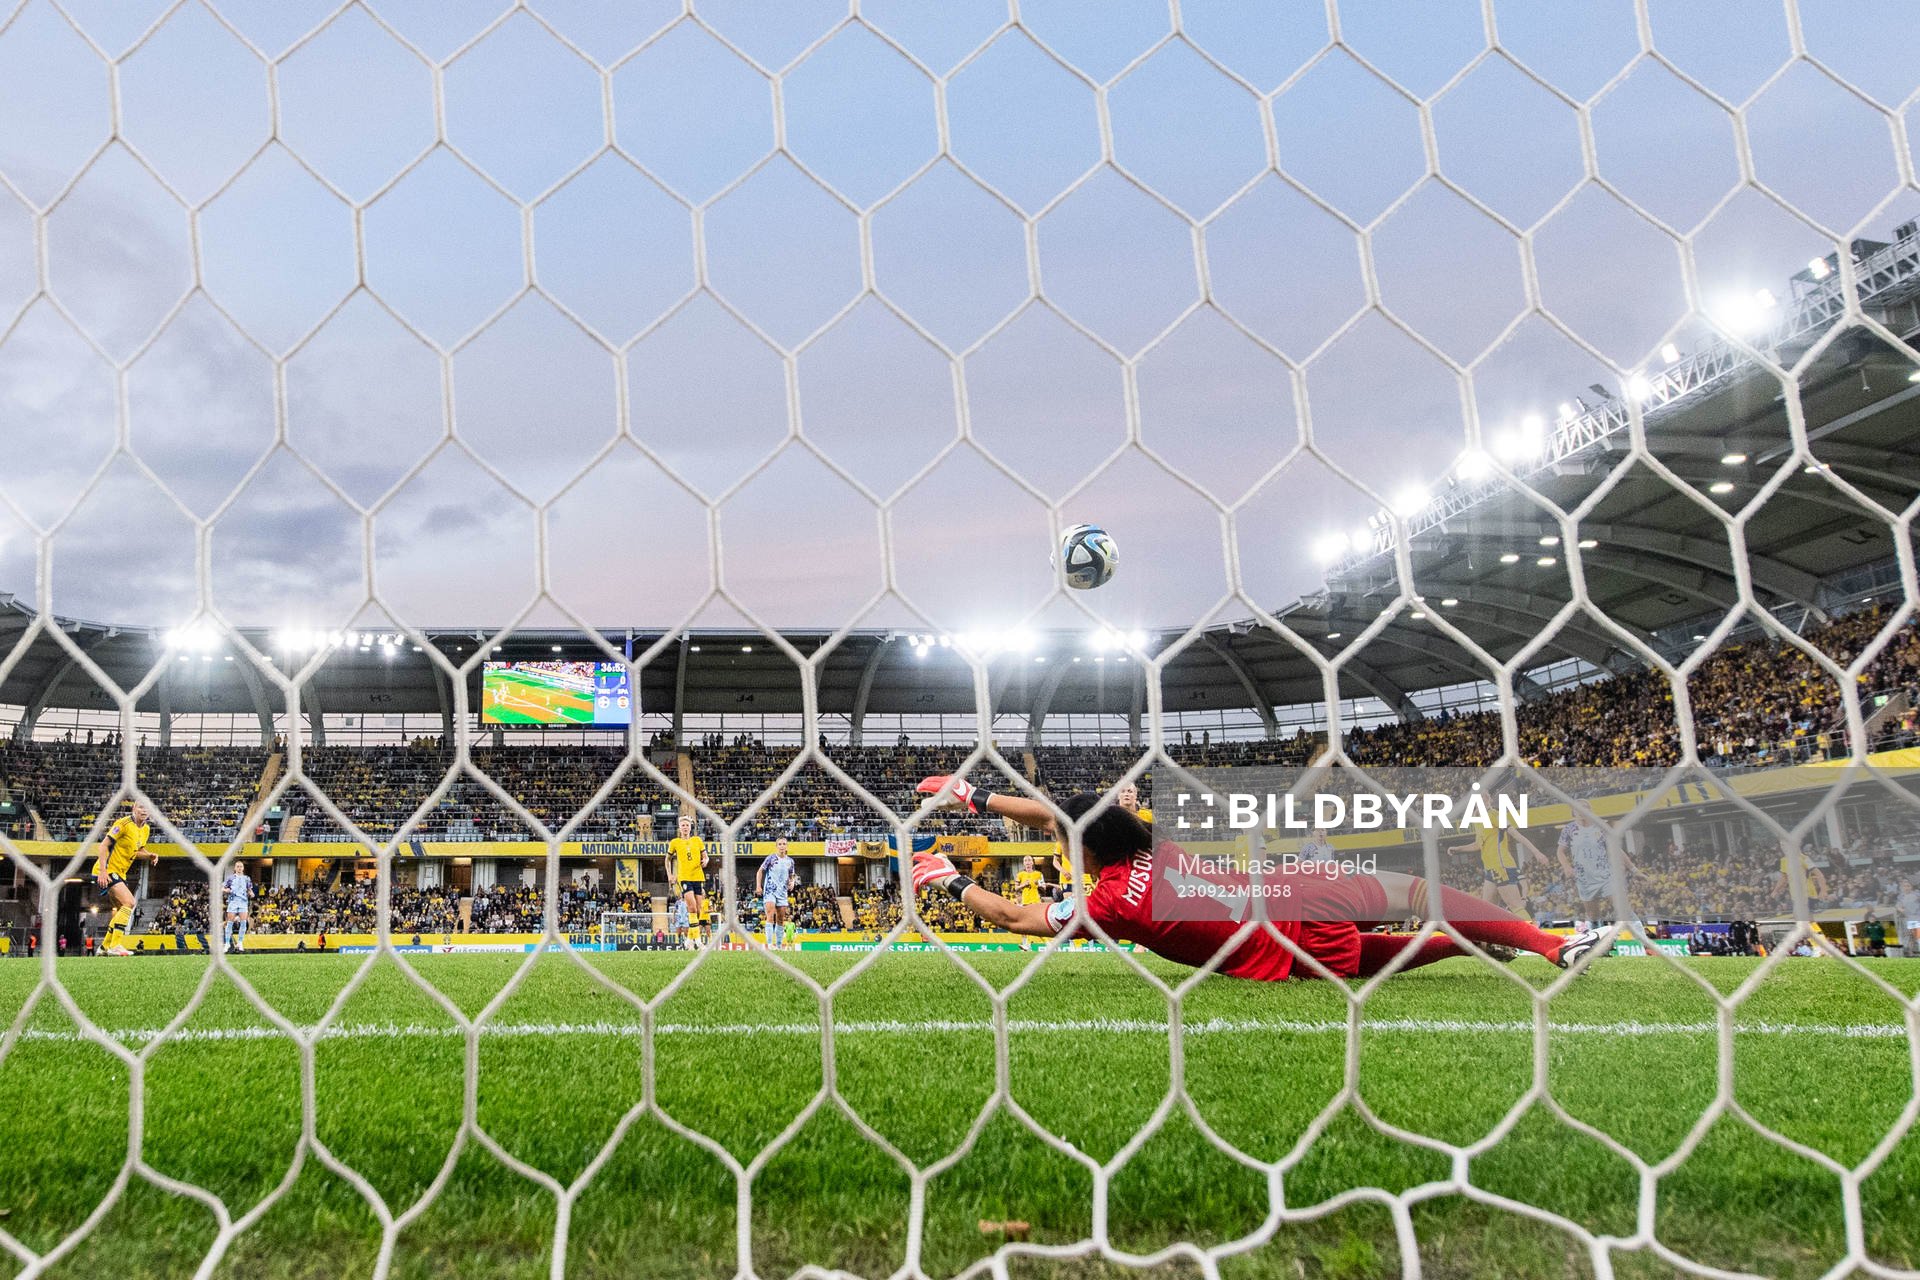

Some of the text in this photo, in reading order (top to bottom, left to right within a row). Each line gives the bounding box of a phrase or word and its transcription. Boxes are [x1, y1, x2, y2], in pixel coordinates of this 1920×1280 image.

[601, 662, 626, 672] 36:52
[620, 676, 626, 685] 0
[686, 852, 692, 861] 8
